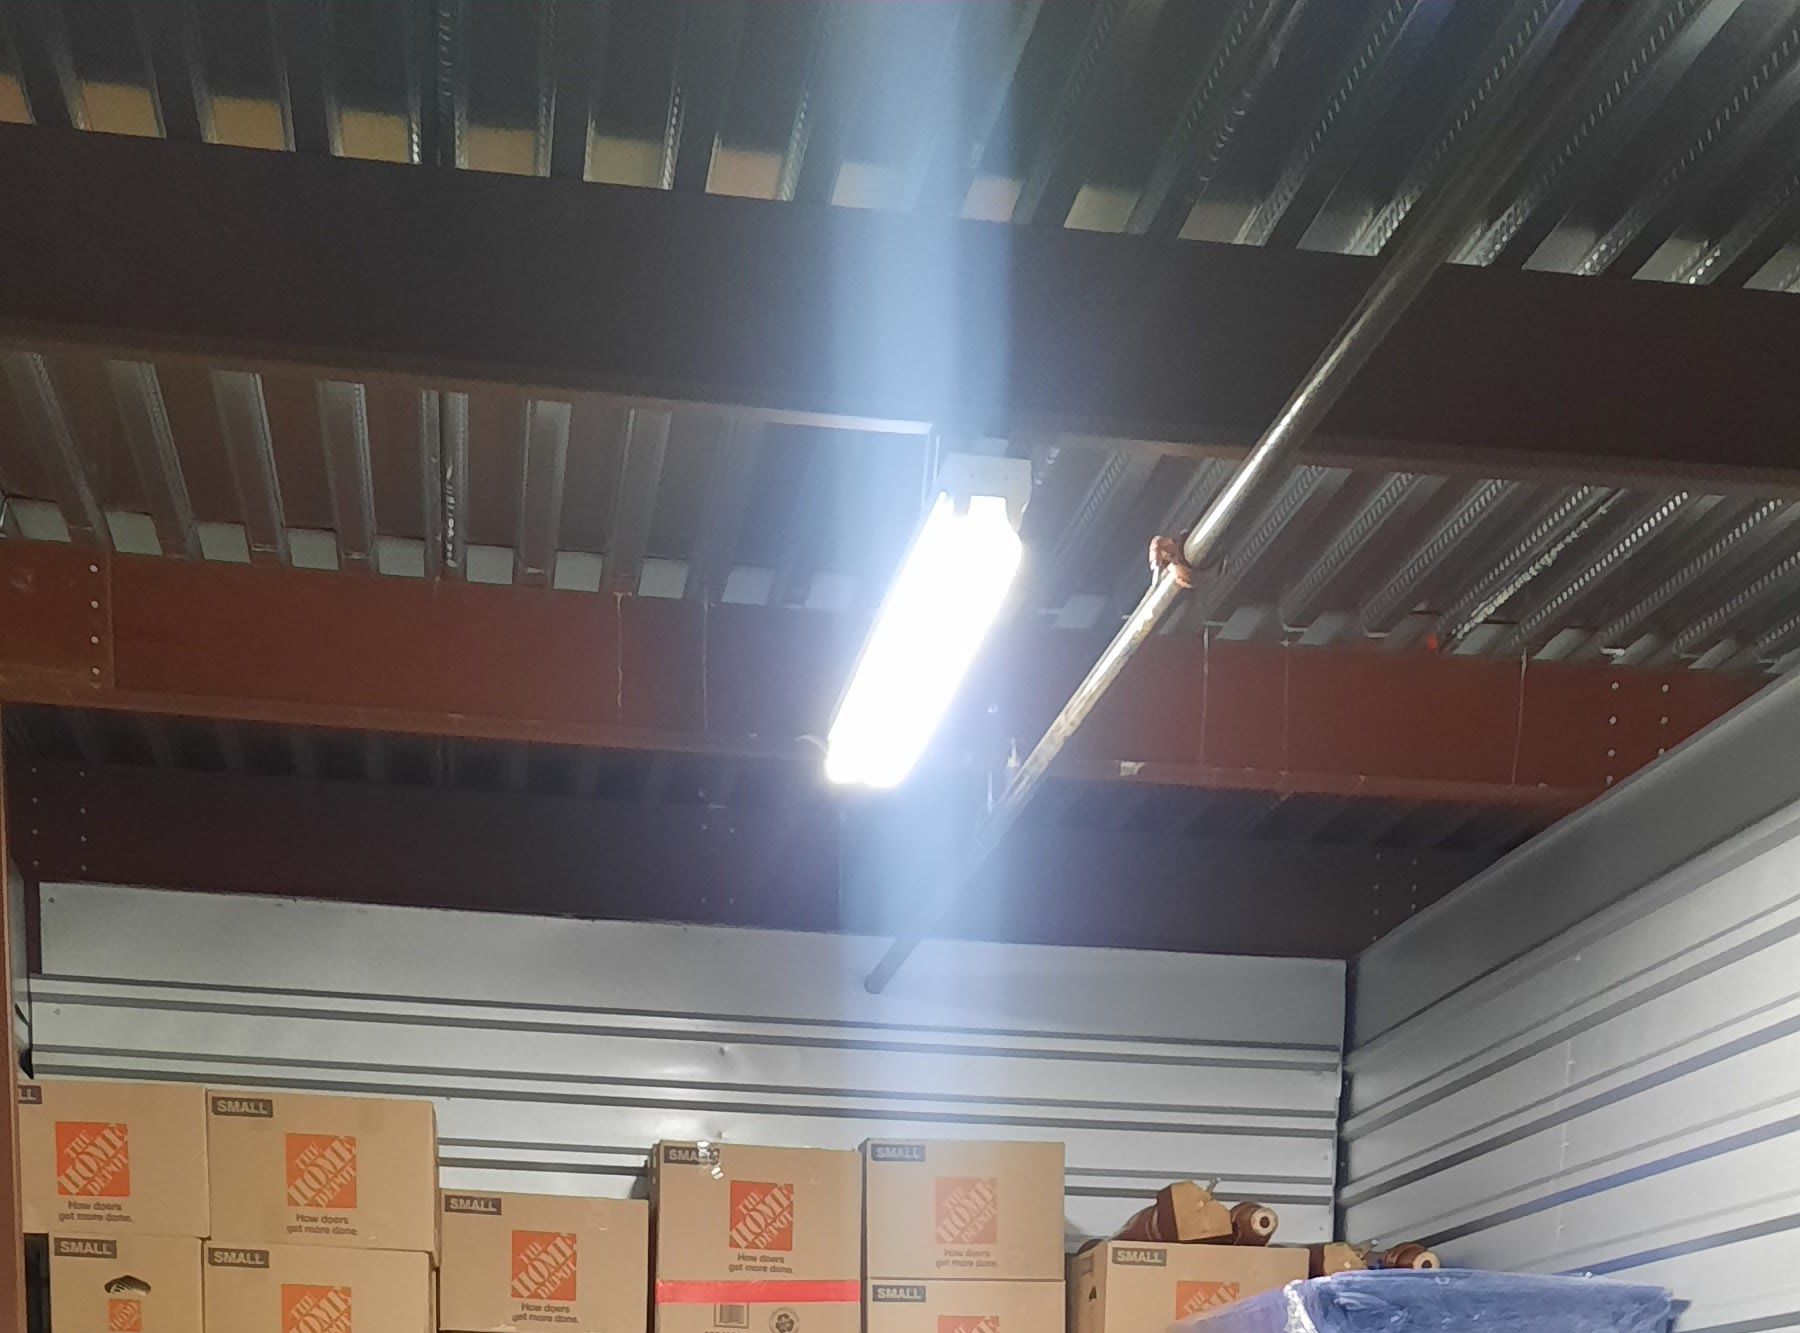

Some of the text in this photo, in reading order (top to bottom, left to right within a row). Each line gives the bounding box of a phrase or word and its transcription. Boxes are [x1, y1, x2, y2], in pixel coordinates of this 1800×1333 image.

[217, 1100, 268, 1114] SMALL
[58, 1124, 128, 1195] HOME
[287, 1137, 356, 1207] HOME
[876, 1147, 920, 1159] SMALL
[86, 1152, 129, 1195] DEPOT
[315, 1165, 356, 1207] DEPOT
[449, 1199, 497, 1211] SMALL
[730, 1183, 793, 1250] HOME
[60, 1241, 113, 1255] SMALL
[755, 1210, 793, 1250] DEPOT
[214, 1251, 265, 1265] SMALL
[513, 1233, 576, 1300] HOME
[1117, 1251, 1162, 1263] SMALL
[538, 1260, 576, 1300] DEPOT
[877, 1287, 921, 1299] SMALL
